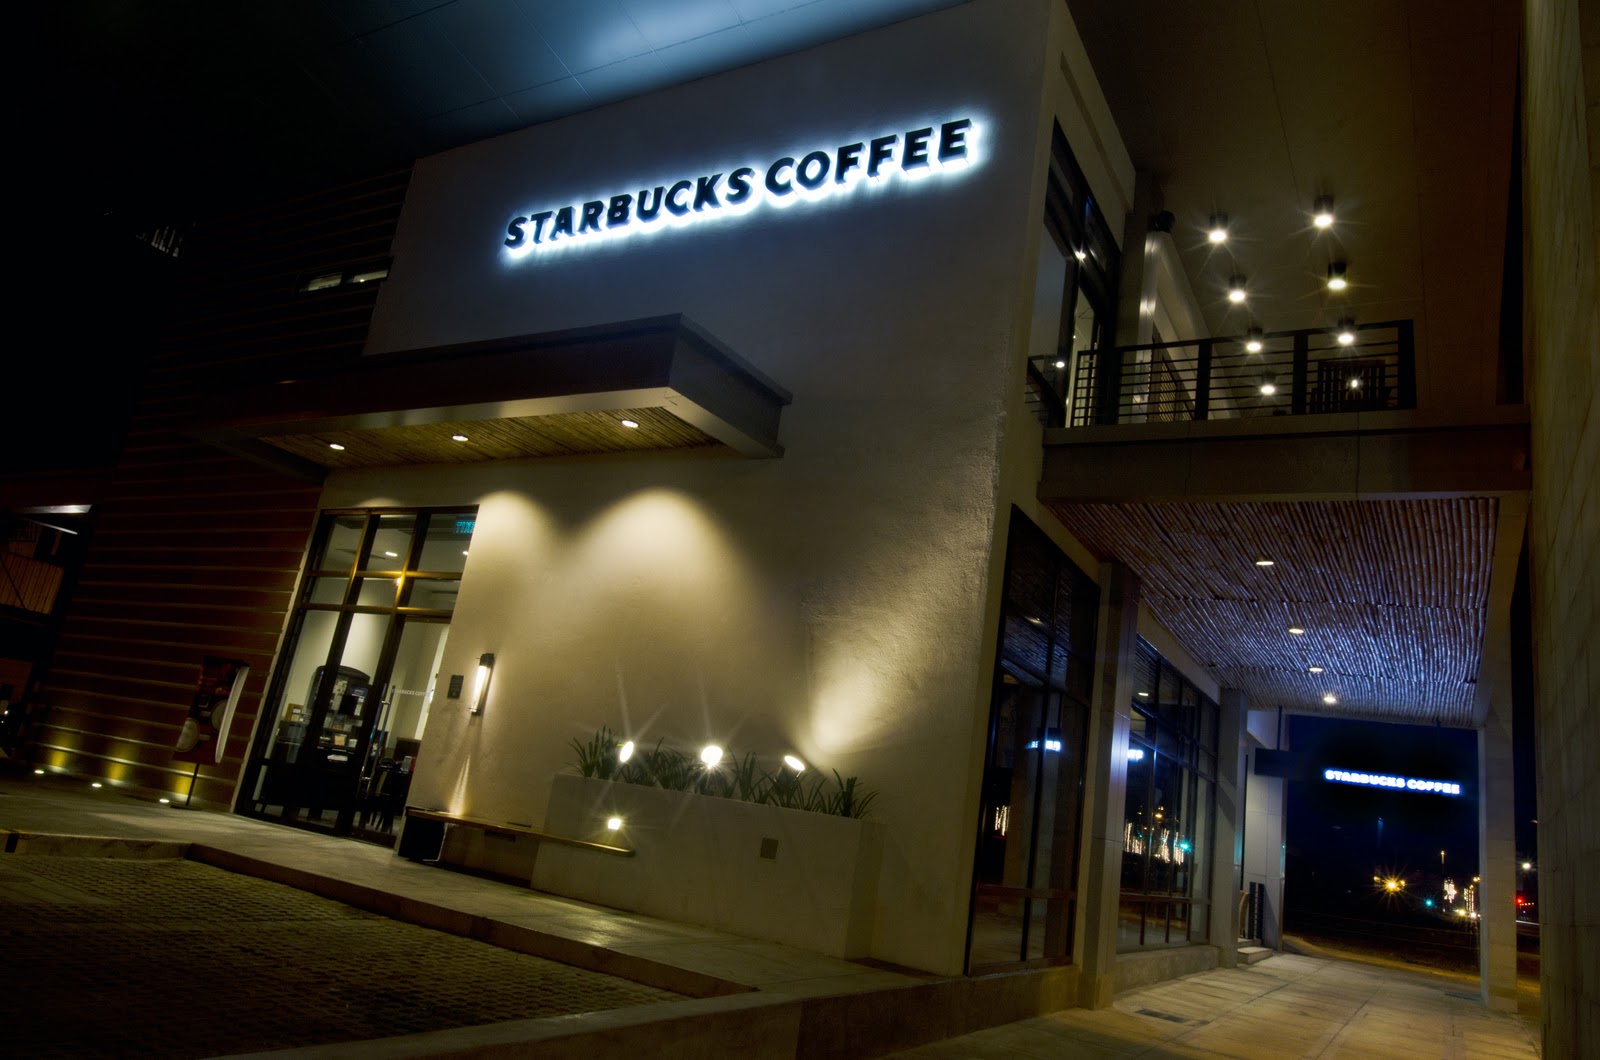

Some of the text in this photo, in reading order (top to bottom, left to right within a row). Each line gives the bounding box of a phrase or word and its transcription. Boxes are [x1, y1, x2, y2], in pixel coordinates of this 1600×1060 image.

[504, 118, 973, 248] STARBUCKS COFFEE
[1325, 770, 1460, 794] STARBUCKS COFFEE
